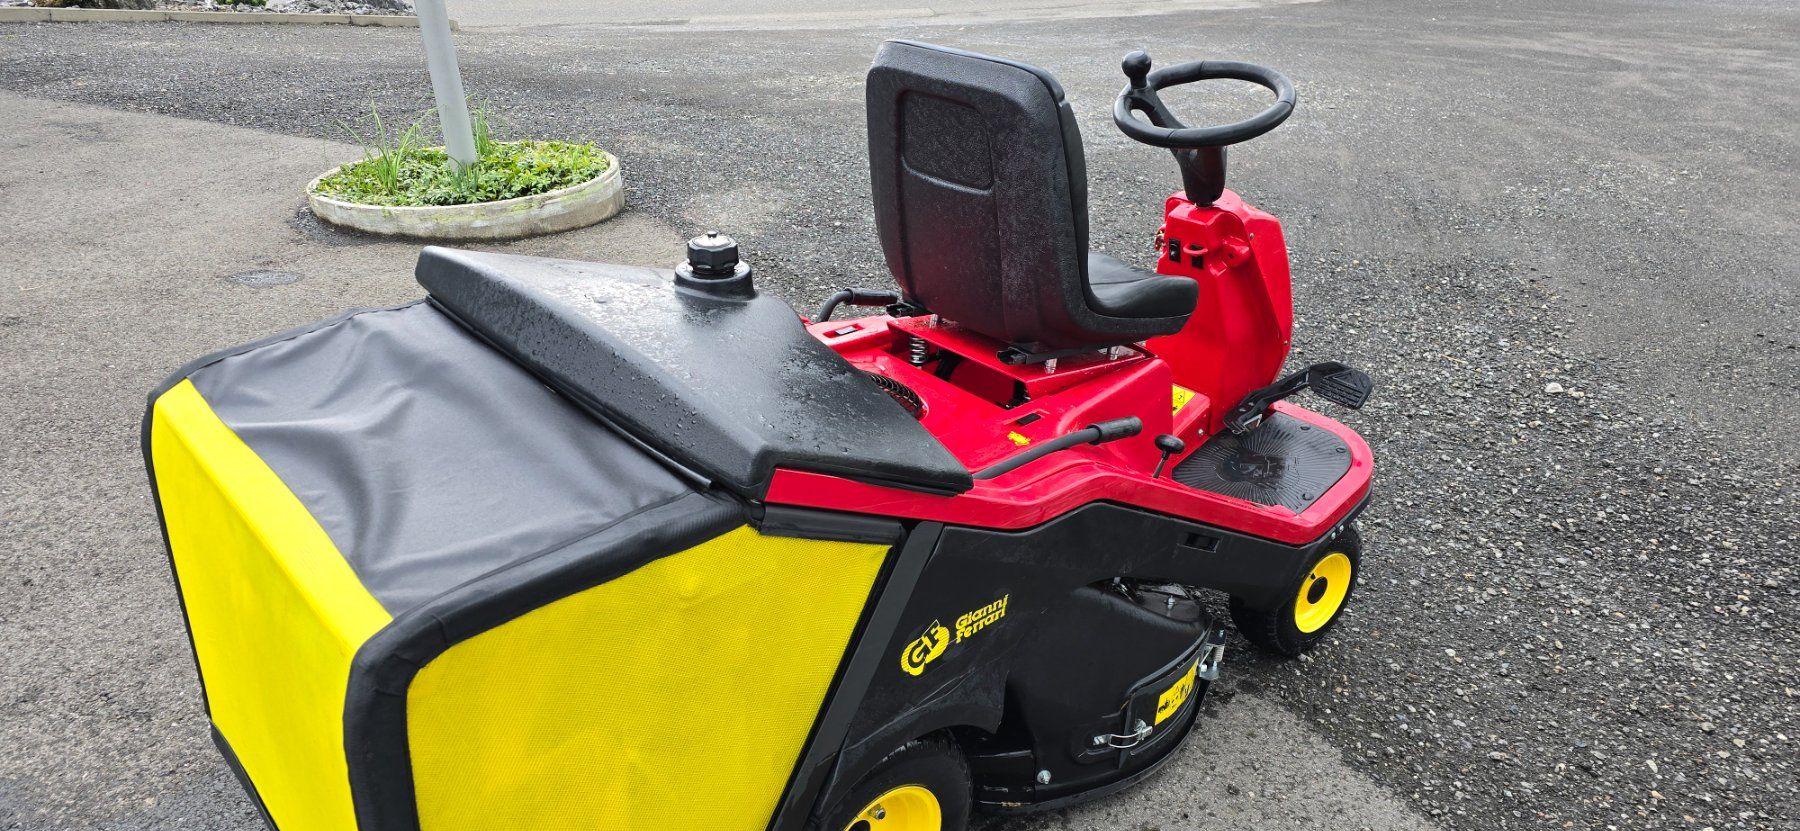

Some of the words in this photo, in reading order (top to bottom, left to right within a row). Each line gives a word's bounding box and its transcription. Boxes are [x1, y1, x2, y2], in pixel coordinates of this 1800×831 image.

[955, 593, 1009, 630] Gianni
[955, 608, 1005, 644] Ferrari
[904, 620, 944, 671] GF
